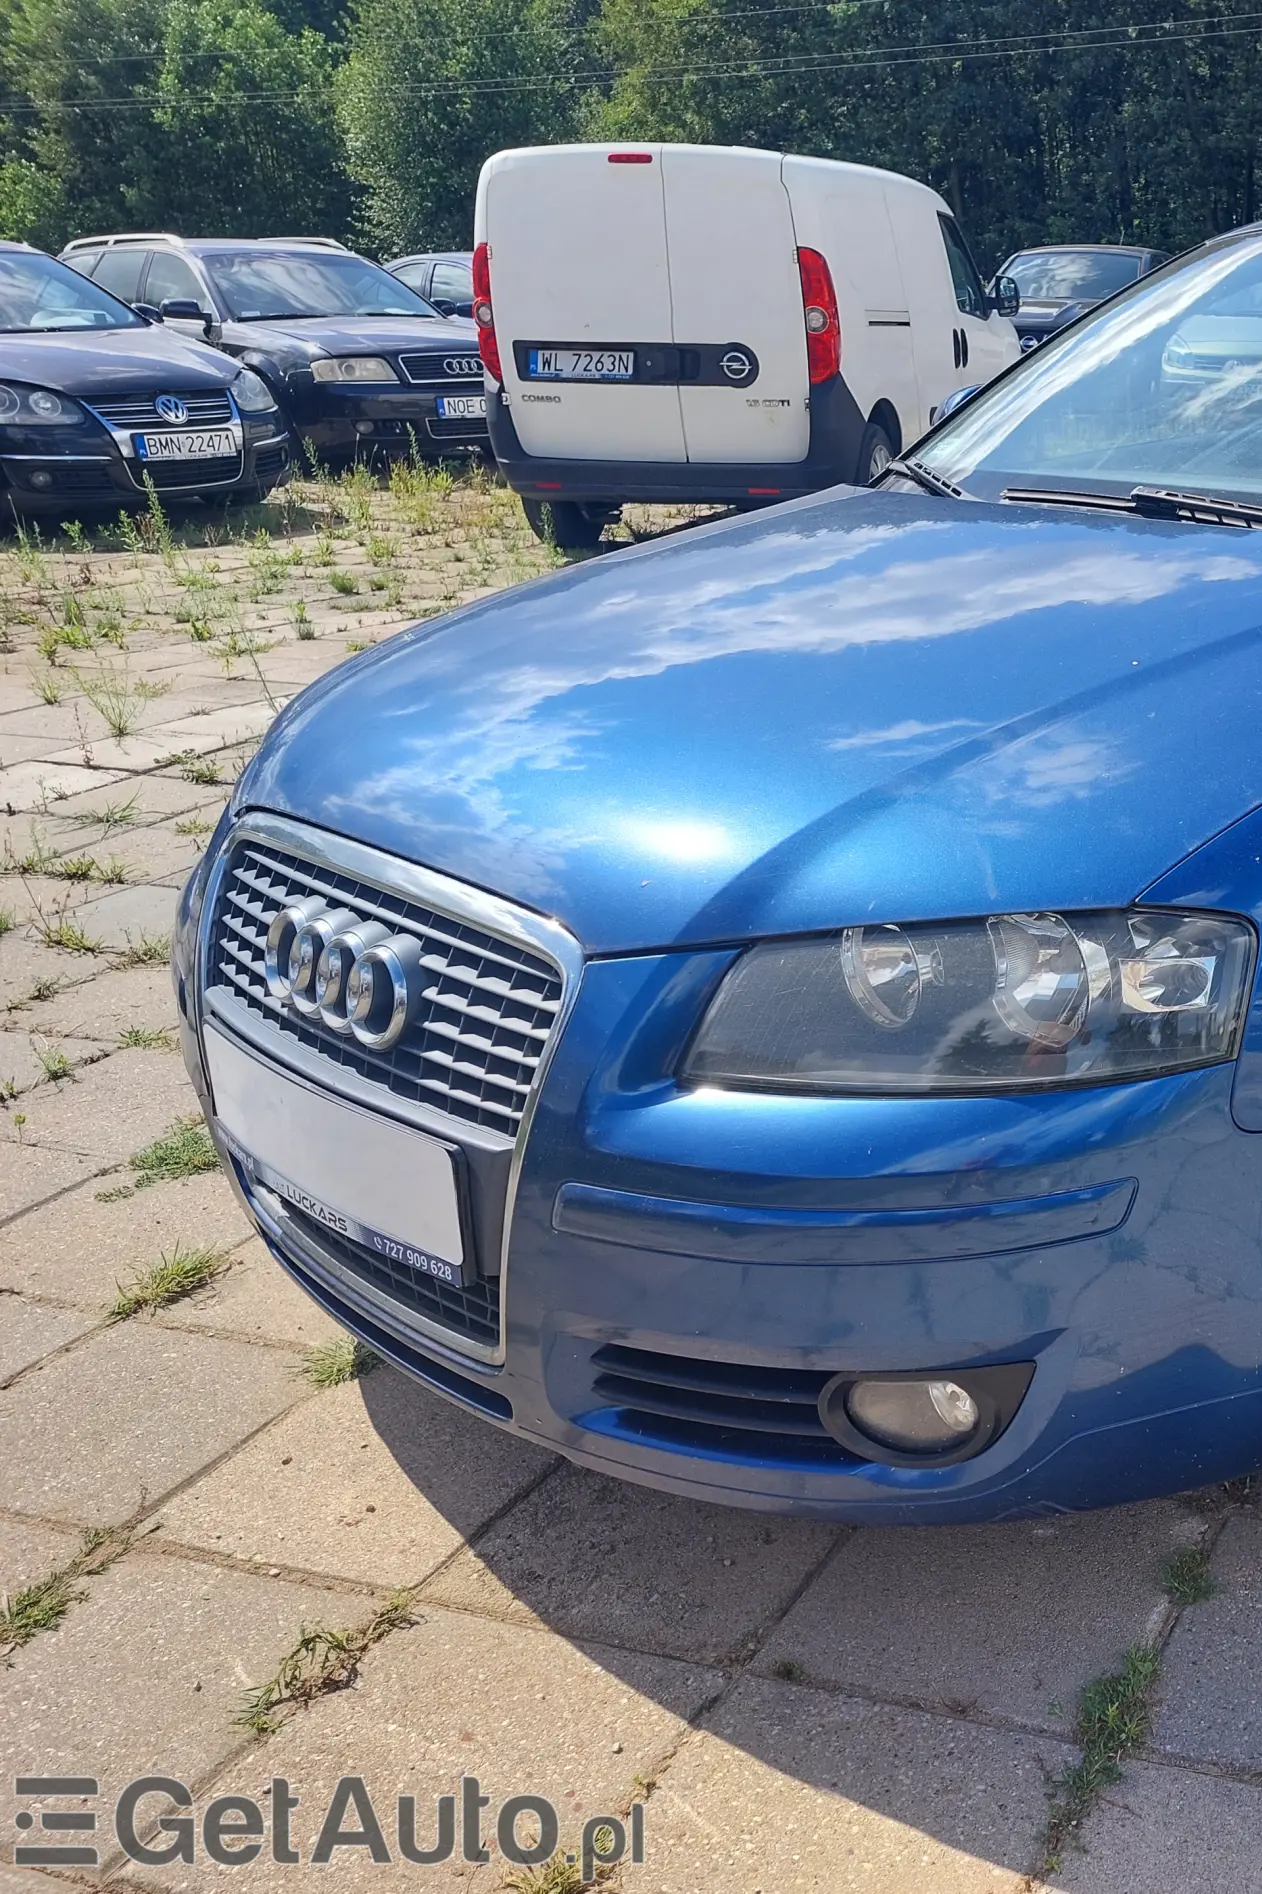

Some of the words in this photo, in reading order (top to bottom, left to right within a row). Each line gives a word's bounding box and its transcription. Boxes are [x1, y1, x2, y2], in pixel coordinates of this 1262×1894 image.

[542, 352, 563, 372] WL
[571, 353, 630, 373] 7263N
[447, 399, 475, 414] NOE
[521, 394, 561, 403] COMBO
[147, 436, 182, 456] BMN
[185, 433, 232, 453] 22471
[286, 1185, 348, 1232] LUCKARS
[383, 1239, 404, 1260] 727
[406, 1247, 428, 1270] 909
[430, 1260, 452, 1281] 628
